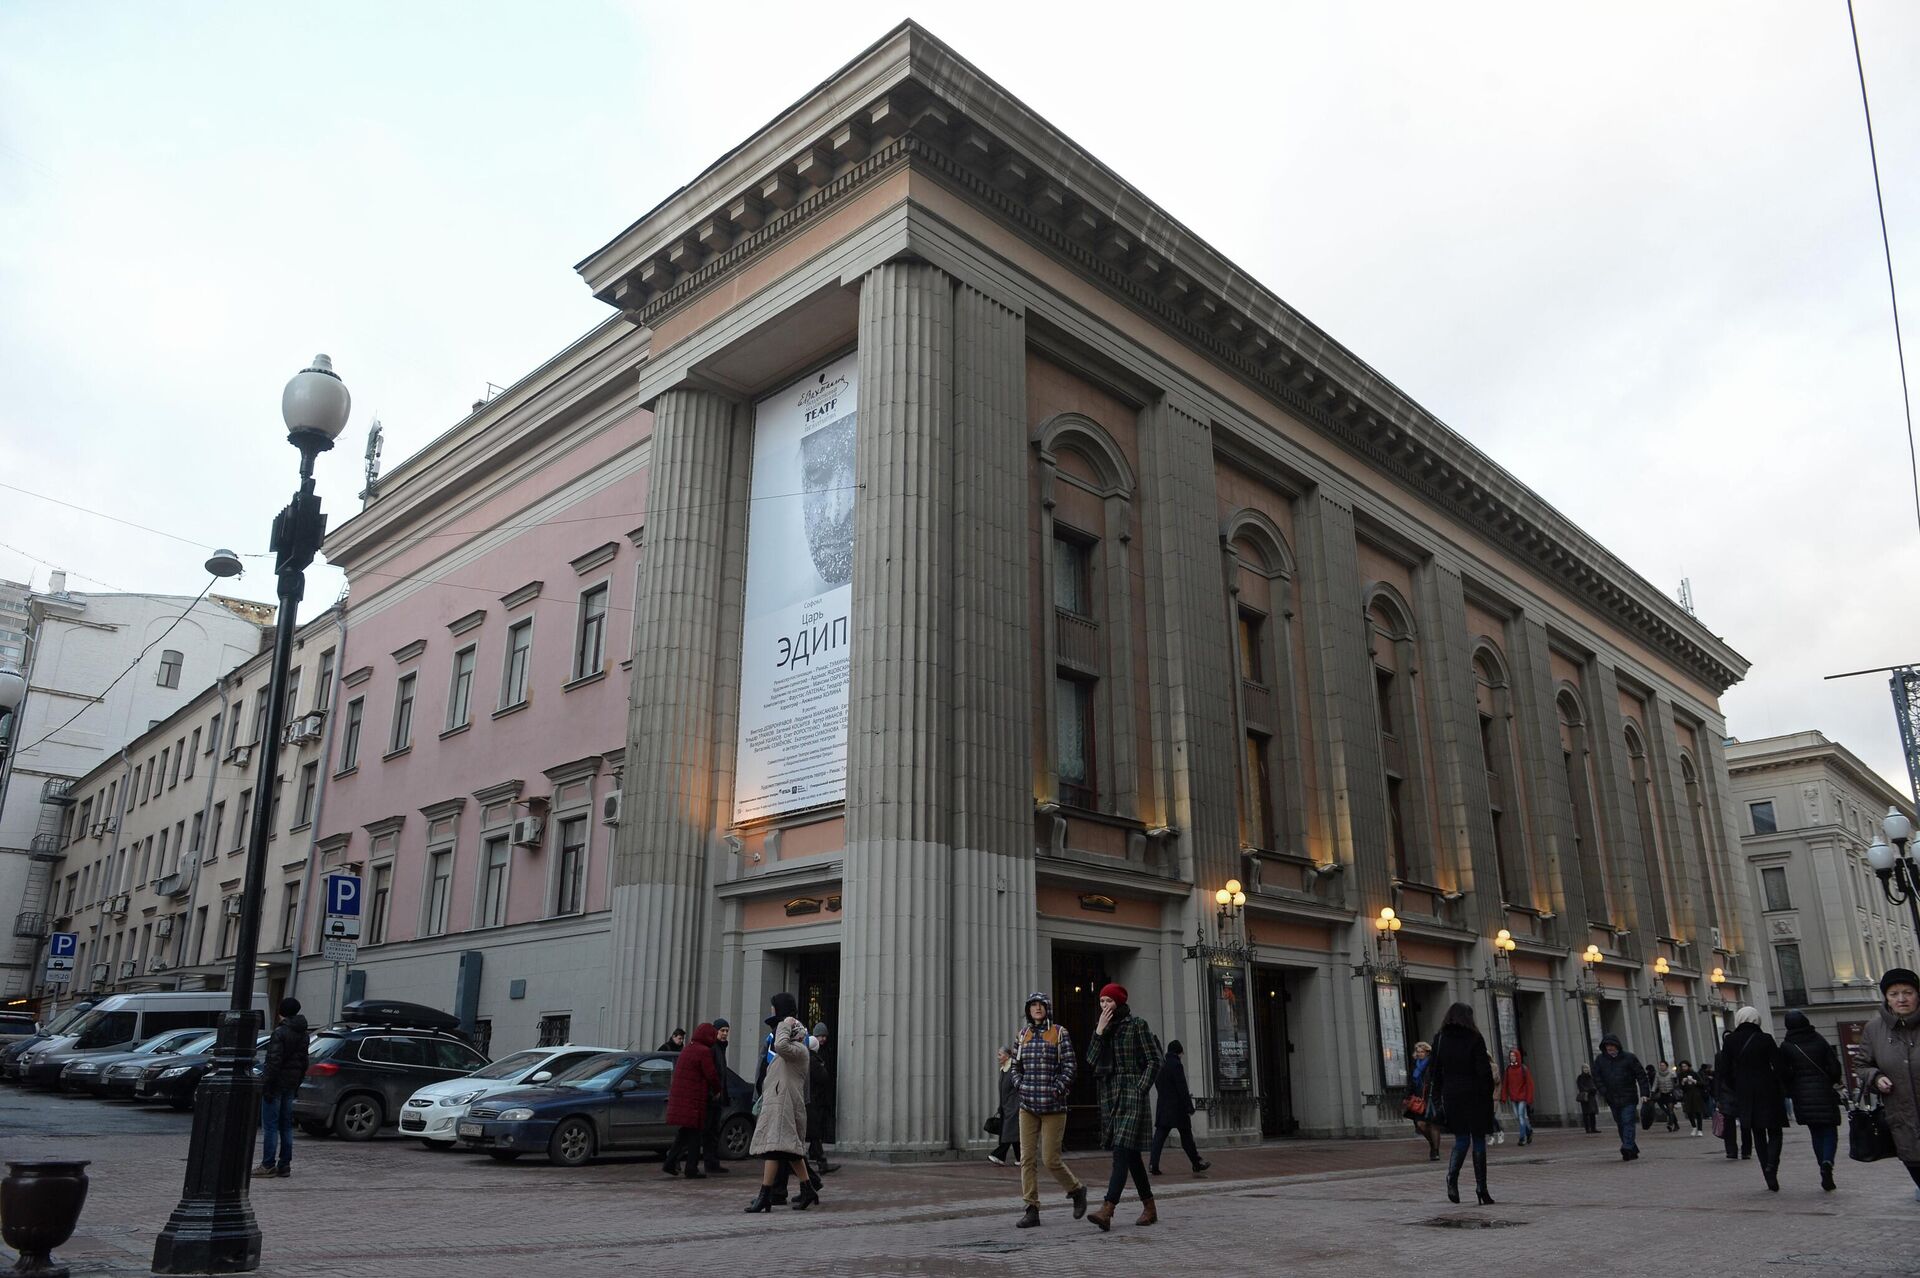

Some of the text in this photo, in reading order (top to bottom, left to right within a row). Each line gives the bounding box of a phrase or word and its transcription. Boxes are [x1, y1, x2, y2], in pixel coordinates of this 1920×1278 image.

[804, 398, 838, 422] ТЕАТР
[802, 611, 824, 626] Царь
[776, 616, 847, 671] ЭДИП
[337, 879, 356, 911] P
[57, 935, 72, 954] P
